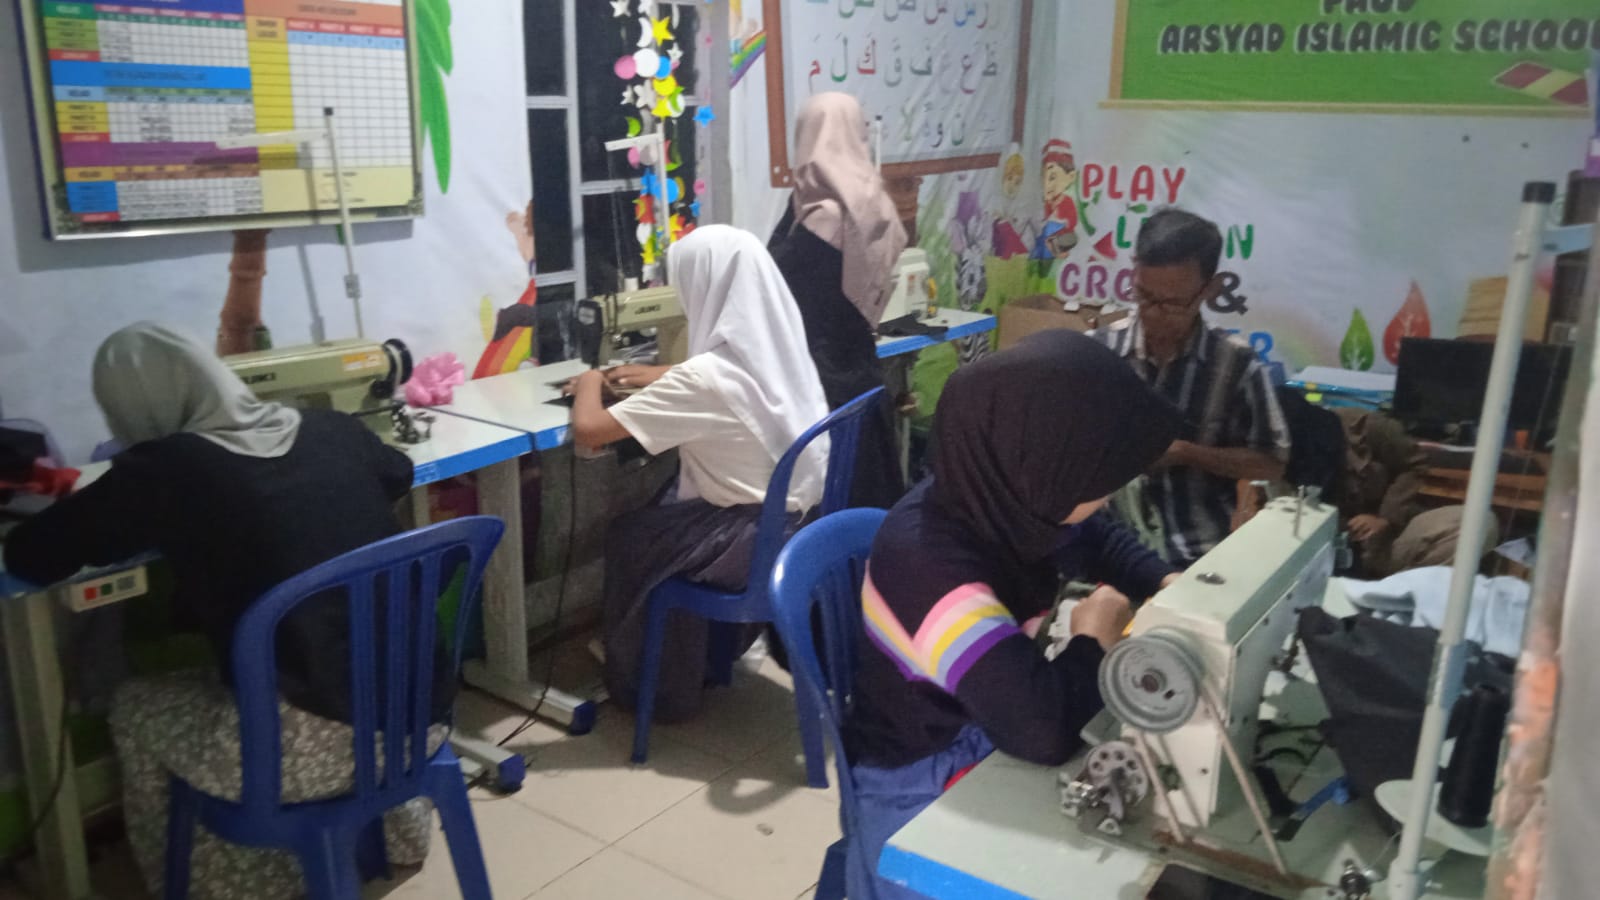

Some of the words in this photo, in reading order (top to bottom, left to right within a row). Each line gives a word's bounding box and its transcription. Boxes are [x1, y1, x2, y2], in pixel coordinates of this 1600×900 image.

[1159, 22, 1285, 54] ARSYAD
[1294, 20, 1442, 53] ISLAMIC
[1082, 163, 1186, 204] PLAY
[1206, 271, 1249, 316] &
